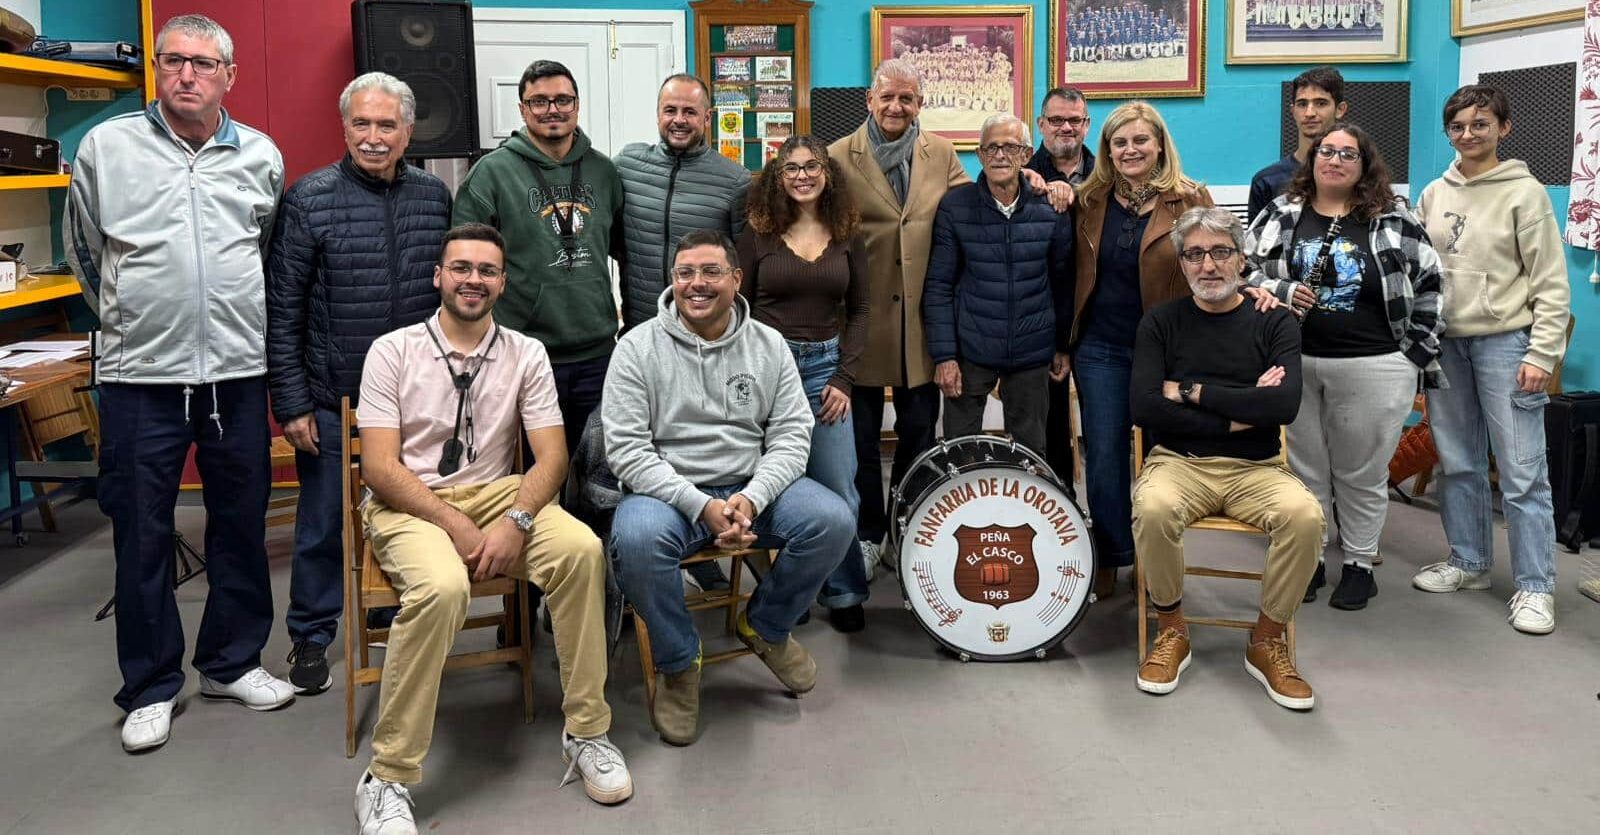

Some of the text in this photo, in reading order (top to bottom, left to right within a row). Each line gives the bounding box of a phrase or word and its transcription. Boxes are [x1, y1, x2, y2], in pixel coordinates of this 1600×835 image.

[528, 184, 596, 213] CLTIS
[548, 246, 592, 267] Bston
[914, 477, 1079, 548] FANFARRIA DE LA OROTAVA
[980, 530, 1011, 543] PEÑA
[966, 546, 1024, 566] EL CASCO
[982, 590, 1010, 600] 1963
